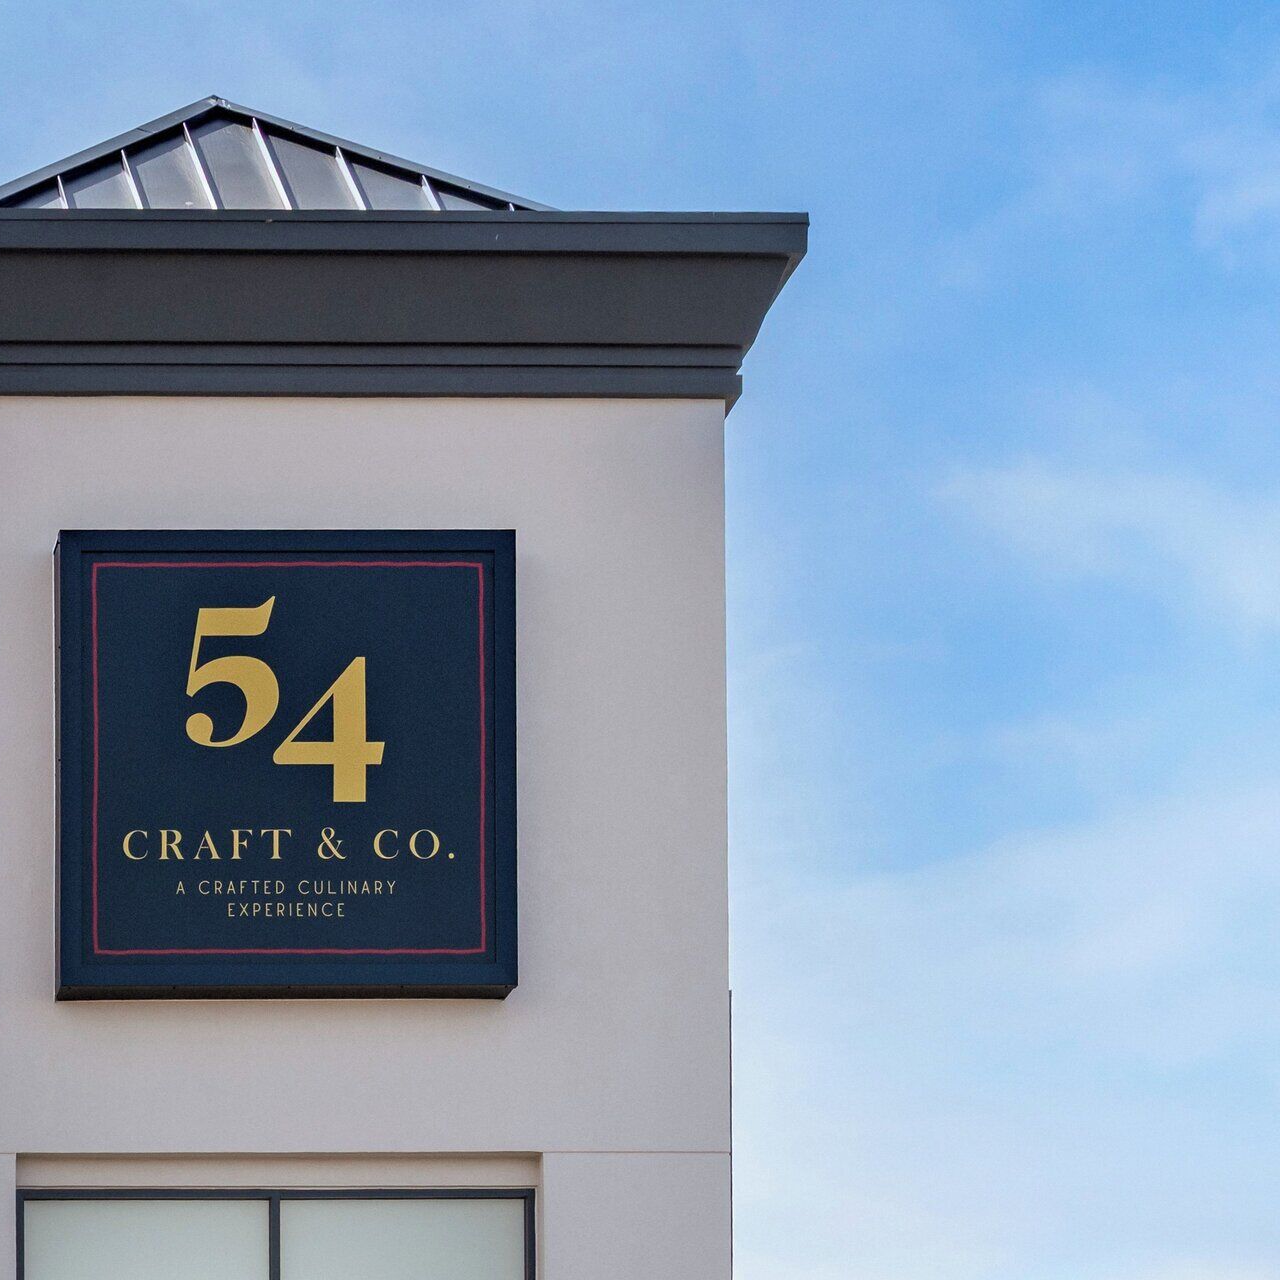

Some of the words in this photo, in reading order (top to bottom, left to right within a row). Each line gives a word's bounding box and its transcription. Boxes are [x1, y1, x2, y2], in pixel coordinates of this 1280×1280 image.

[185, 595, 385, 802] 54
[122, 828, 292, 860] CRAFT
[317, 826, 347, 860] &
[373, 828, 456, 860] CO.
[176, 880, 186, 895] A
[198, 879, 286, 895] CRAFTED
[298, 879, 397, 895] CULINARY
[227, 902, 345, 918] EXPERIENCE
